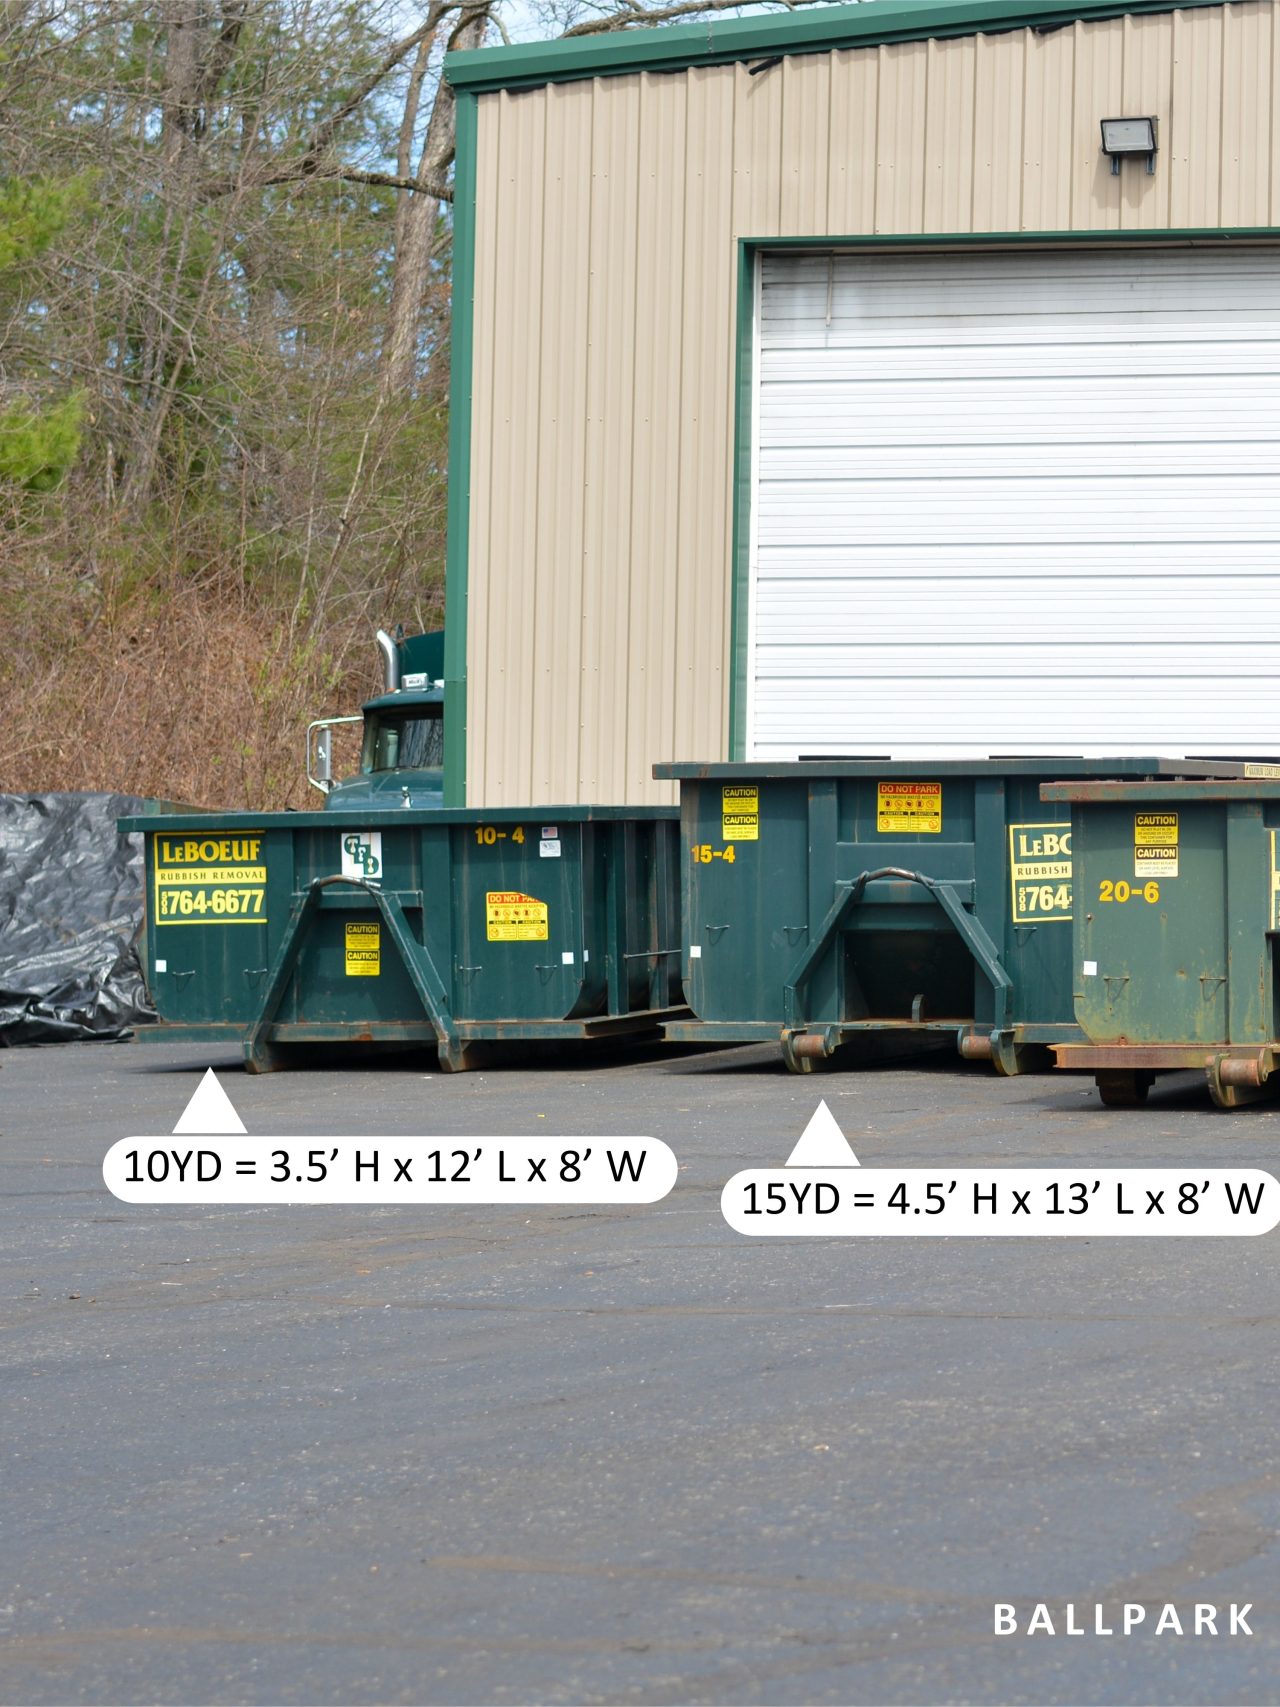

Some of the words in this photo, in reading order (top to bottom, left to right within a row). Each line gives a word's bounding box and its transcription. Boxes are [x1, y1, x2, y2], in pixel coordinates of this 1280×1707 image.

[724, 789, 756, 797] CAUTION
[881, 785, 894, 793] DO
[896, 785, 914, 793] NOT
[915, 785, 938, 793] PARK
[725, 816, 756, 824] CAUTION
[1137, 816, 1175, 825] CAUTION
[1019, 832, 1072, 857] LeBO
[691, 844, 736, 864] 15-4
[1137, 849, 1176, 858] CAUTION
[160, 870, 207, 881] RUBBISH
[212, 869, 264, 880] REMOVAL
[1017, 865, 1068, 876] RUBBISH
[1099, 880, 1160, 904] 20-6
[169, 889, 264, 915] 764-6677
[489, 895, 502, 903] DO
[503, 895, 520, 903] NOT
[347, 925, 378, 934] CAUTION
[347, 951, 378, 960] CAUTION
